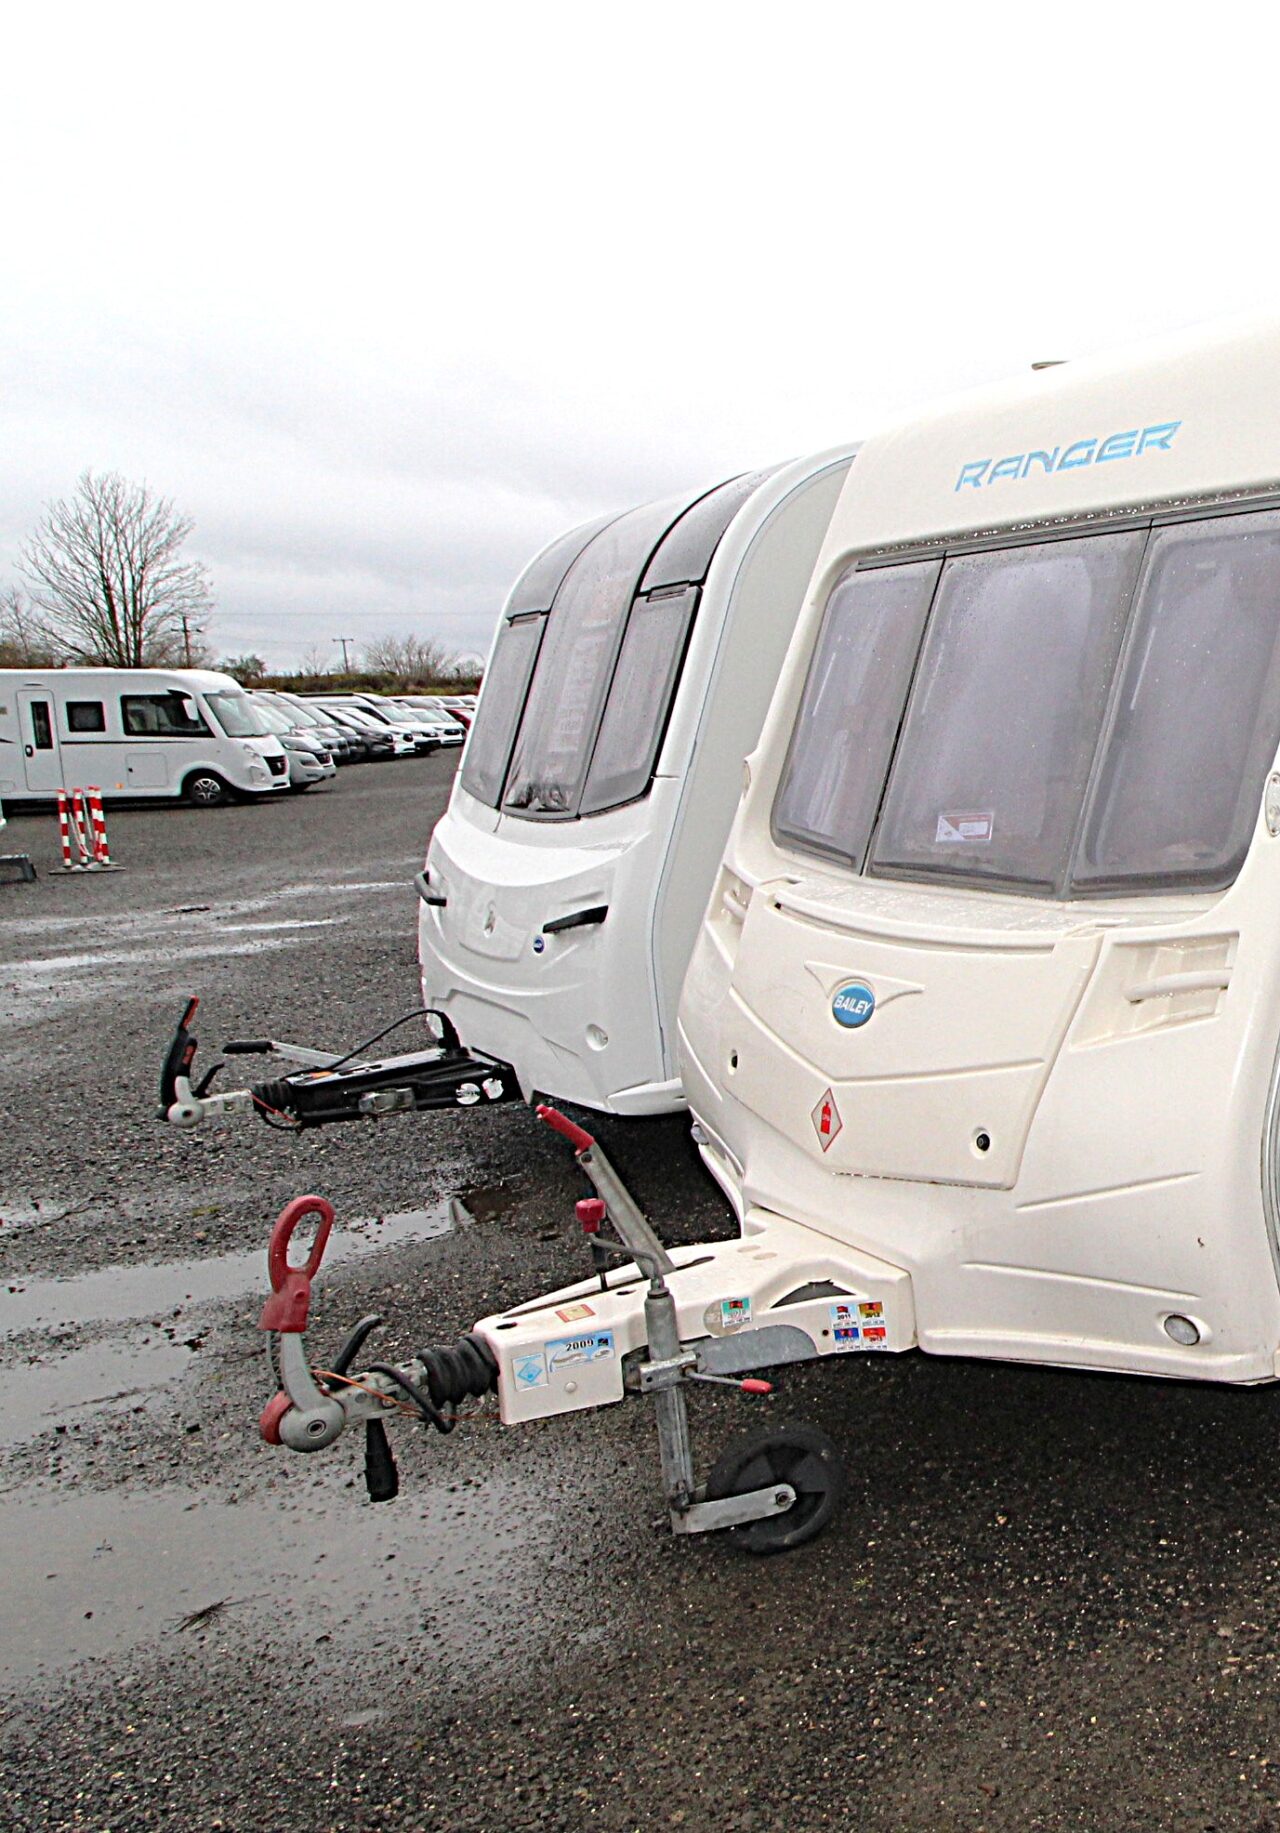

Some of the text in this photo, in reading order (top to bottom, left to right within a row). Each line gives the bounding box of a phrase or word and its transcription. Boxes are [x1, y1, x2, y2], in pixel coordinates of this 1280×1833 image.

[954, 420, 1183, 492] RANGER
[833, 994, 873, 1015] BAILEY
[565, 1338, 594, 1352] 2009
